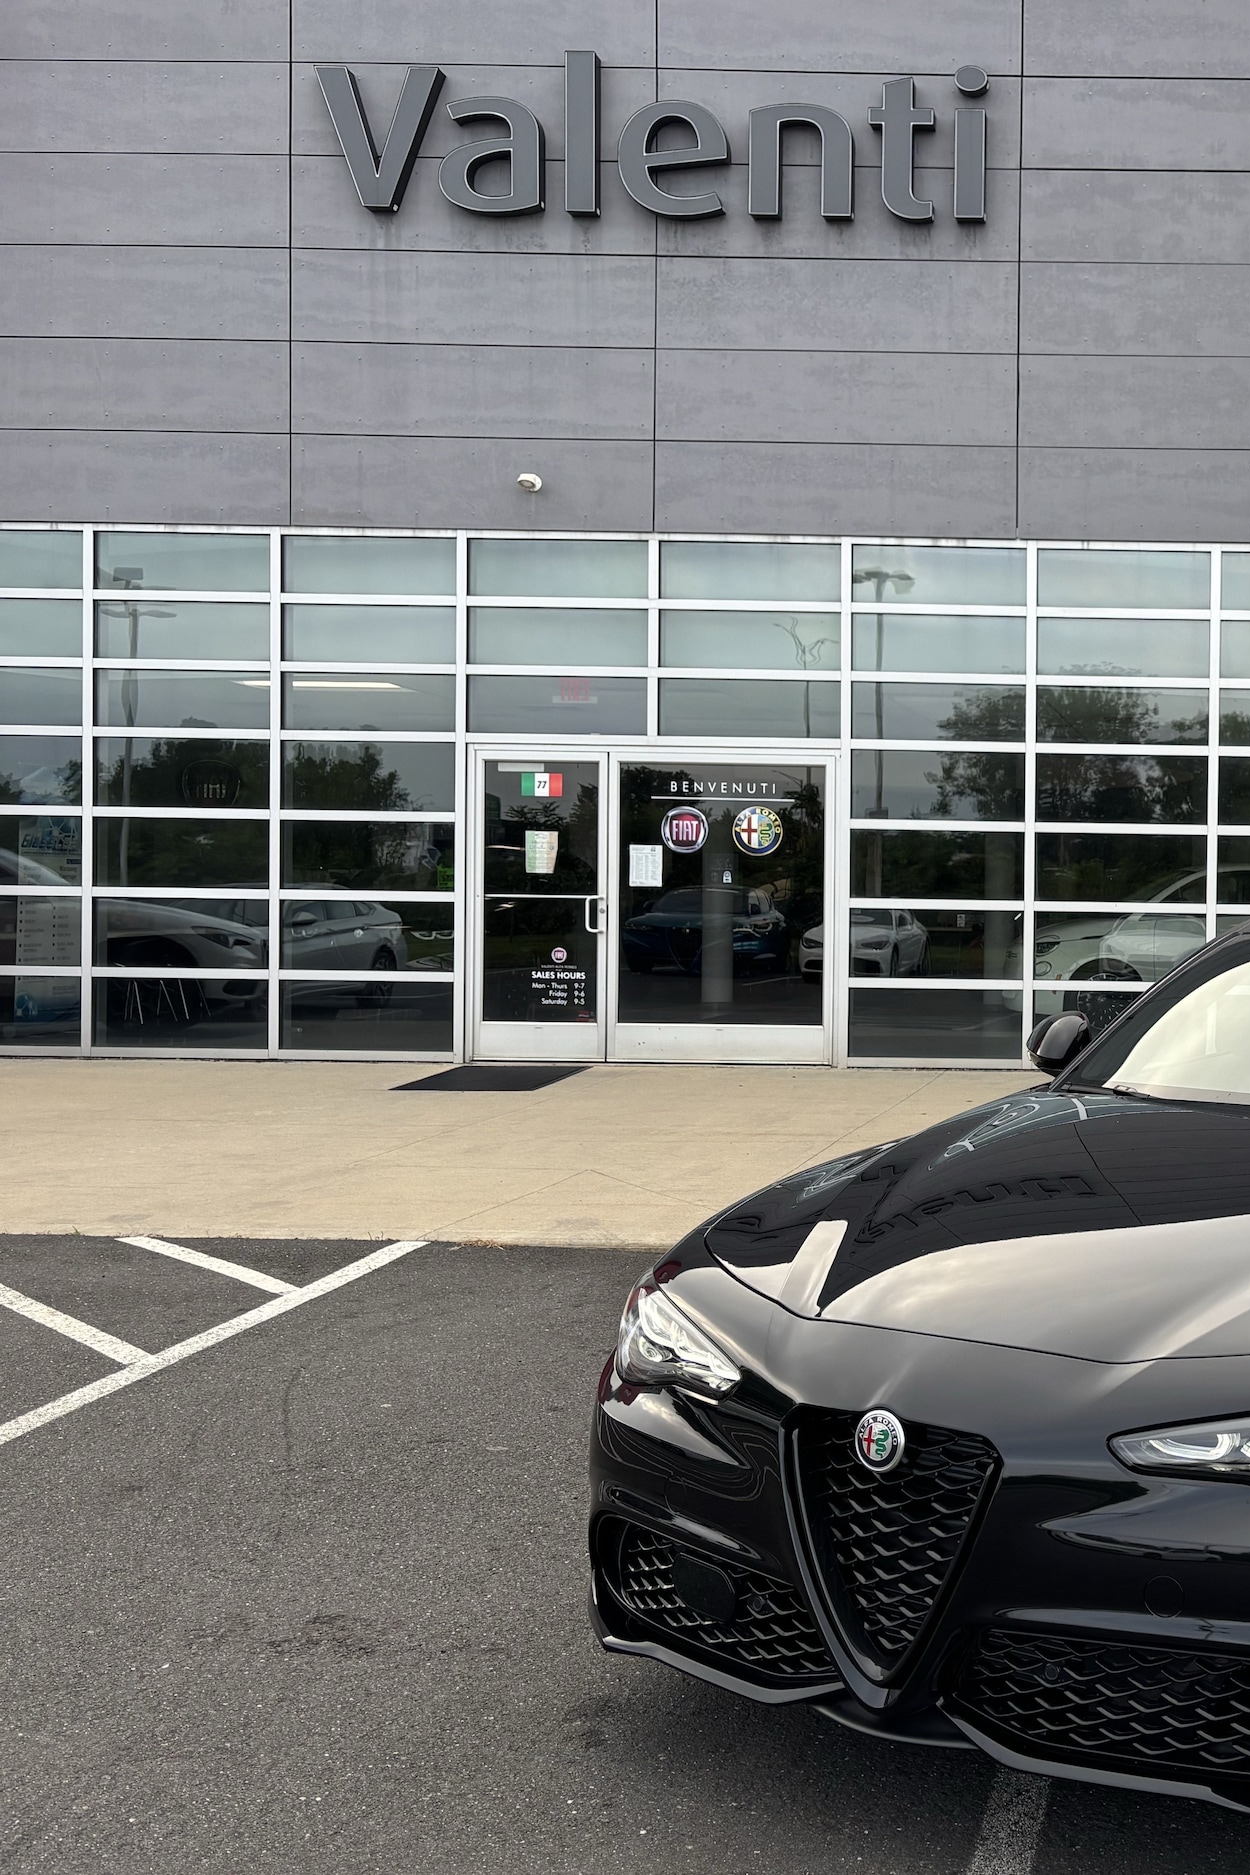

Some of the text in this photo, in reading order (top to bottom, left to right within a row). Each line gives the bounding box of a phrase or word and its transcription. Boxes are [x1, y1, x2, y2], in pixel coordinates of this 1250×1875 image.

[313, 50, 990, 225] Valenti
[537, 781, 548, 789] 77
[670, 781, 776, 794] BENVENUTI
[735, 808, 781, 833] ALFA ROMEO
[672, 820, 699, 841] FIAT
[532, 971, 555, 979] SALES
[549, 990, 567, 998] Friday
[541, 998, 567, 1006] Saturday
[859, 1416, 898, 1445] ALFA ROMEO
